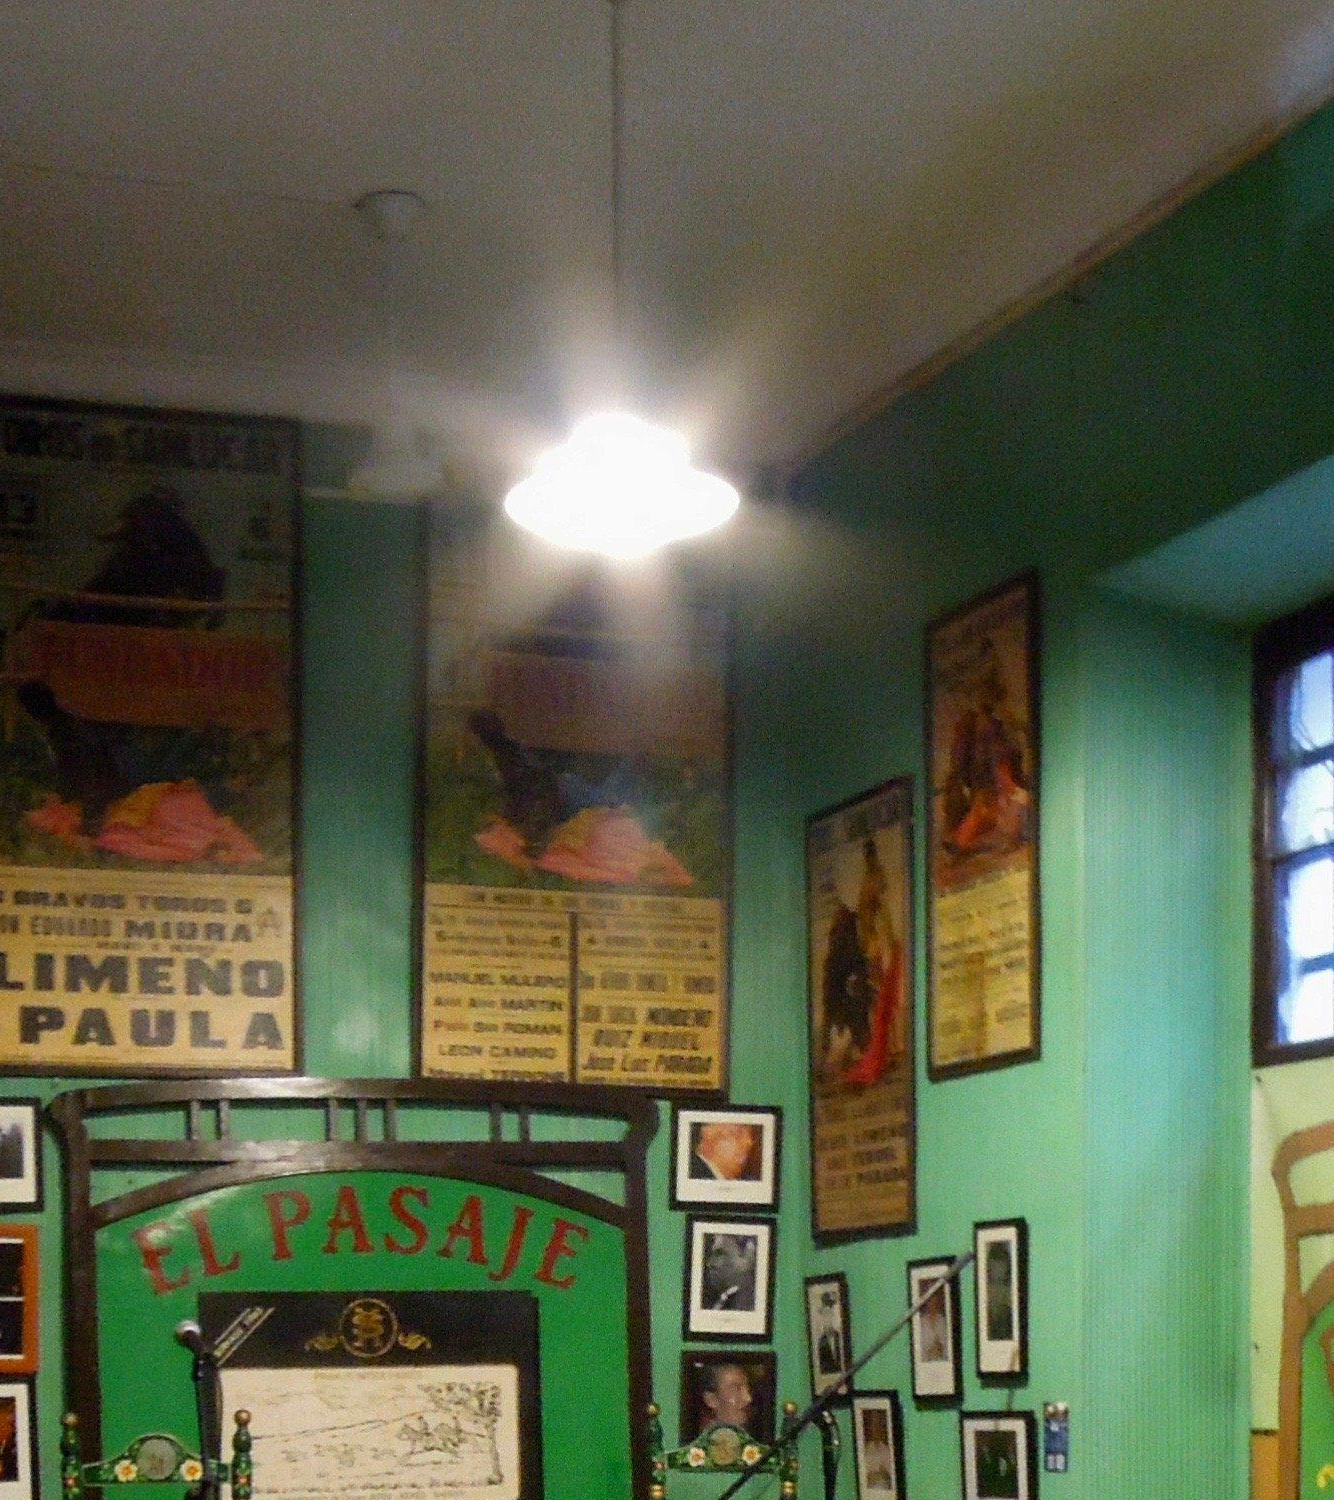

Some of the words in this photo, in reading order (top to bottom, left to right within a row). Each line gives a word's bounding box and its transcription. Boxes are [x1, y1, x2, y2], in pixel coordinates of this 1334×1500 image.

[20, 1006, 284, 1051] PAULA
[134, 1206, 241, 1296] EL
[267, 1186, 592, 1290] PASAJE
